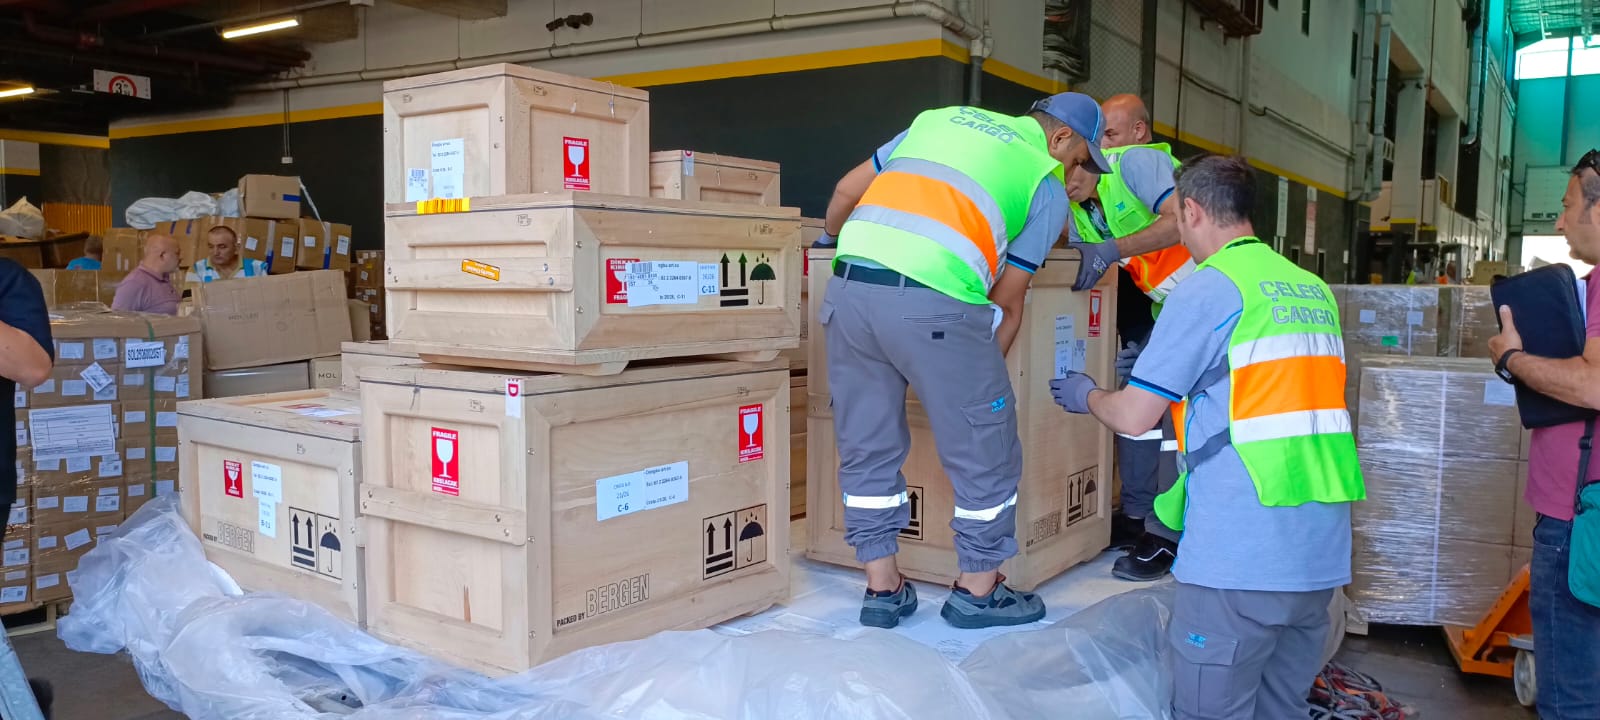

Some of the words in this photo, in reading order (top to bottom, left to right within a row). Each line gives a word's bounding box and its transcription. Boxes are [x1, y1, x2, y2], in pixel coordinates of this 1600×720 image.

[950, 115, 1014, 144] CARGO
[701, 285, 716, 294] C-11
[1271, 305, 1335, 327] CARGO
[432, 430, 457, 440] FRAGILE
[617, 502, 629, 513] C-6
[217, 520, 255, 554] BERGEN
[556, 614, 577, 627] PACKED
[578, 612, 585, 621] BY
[585, 573, 650, 618] BERGEN
